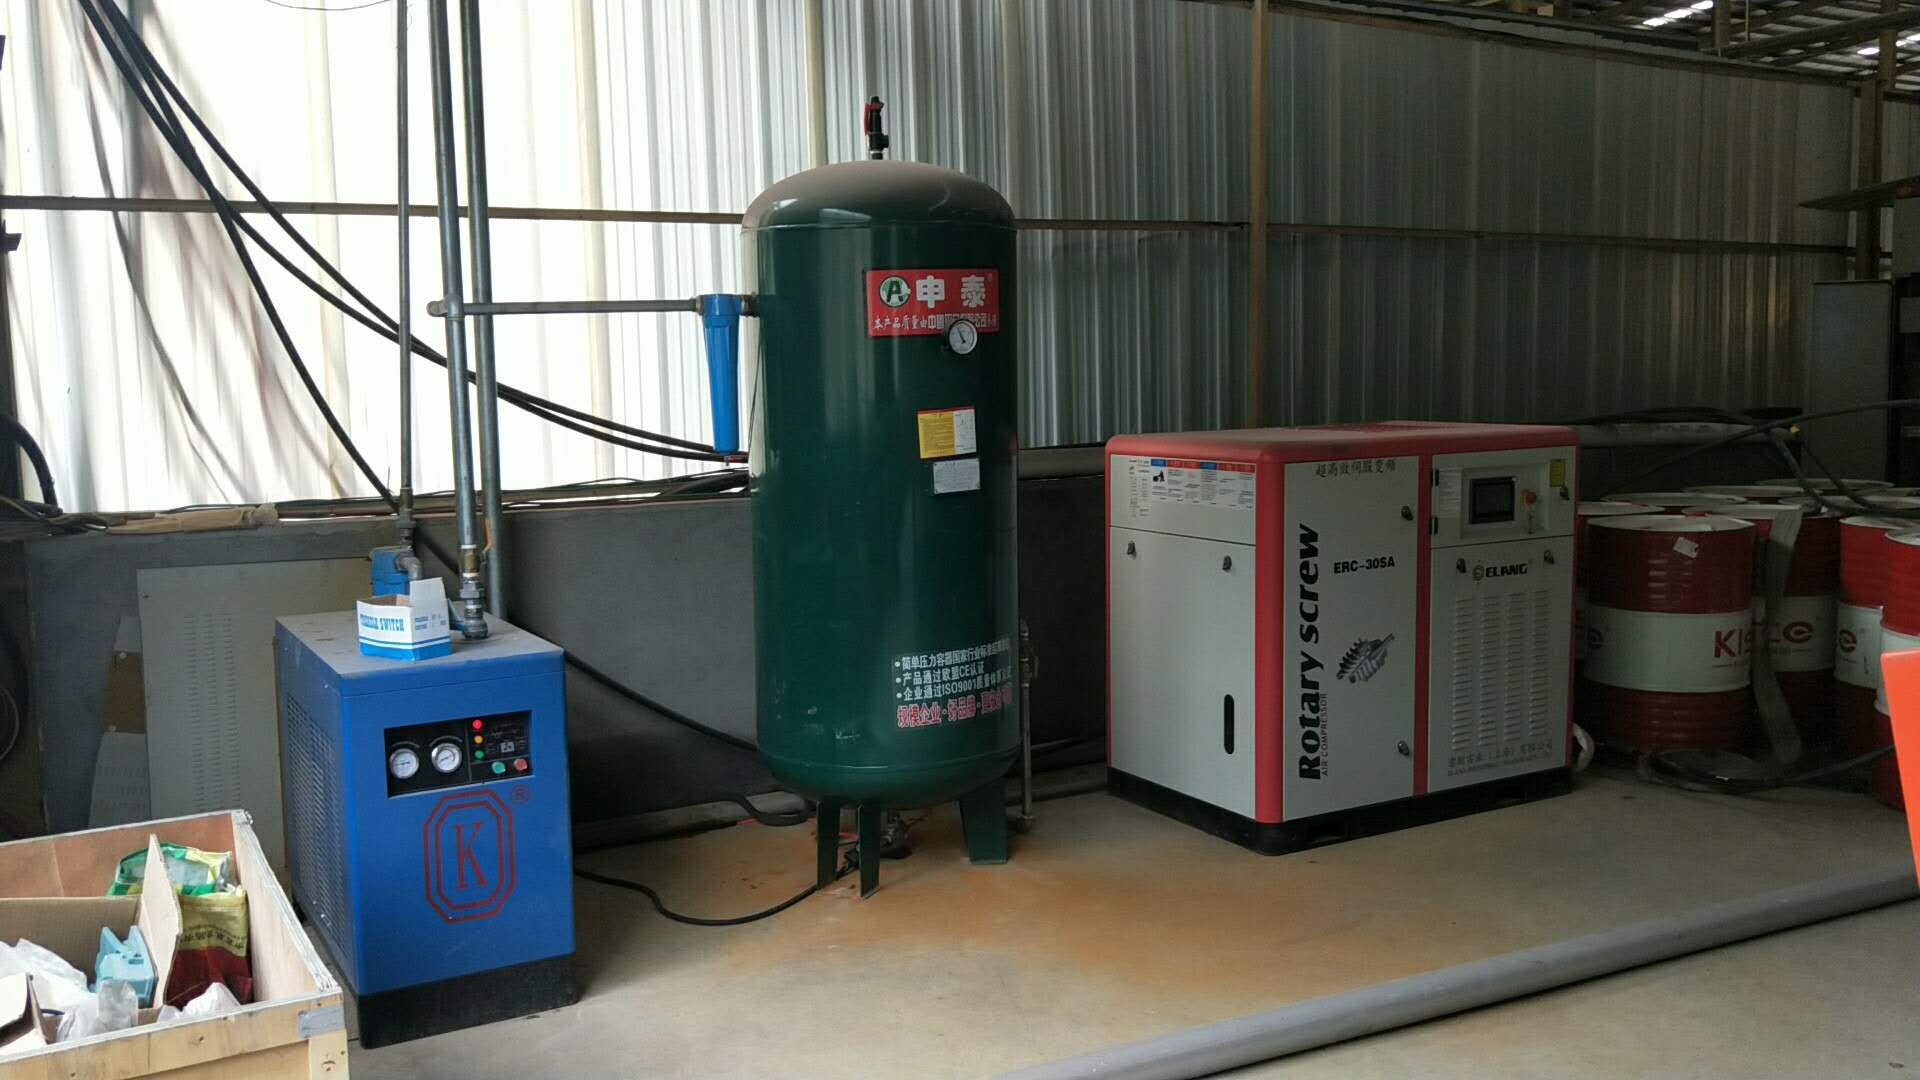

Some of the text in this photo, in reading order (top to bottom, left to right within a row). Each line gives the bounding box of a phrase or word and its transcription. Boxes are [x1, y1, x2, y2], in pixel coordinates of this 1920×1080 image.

[916, 275, 986, 309] 申泰
[1334, 556, 1395, 574] ERC-30SA
[1486, 563, 1528, 578] ELANG
[1299, 523, 1324, 780] Rotary screw
[1320, 693, 1329, 777] AIR COMPRESSOR
[454, 822, 488, 891] K
